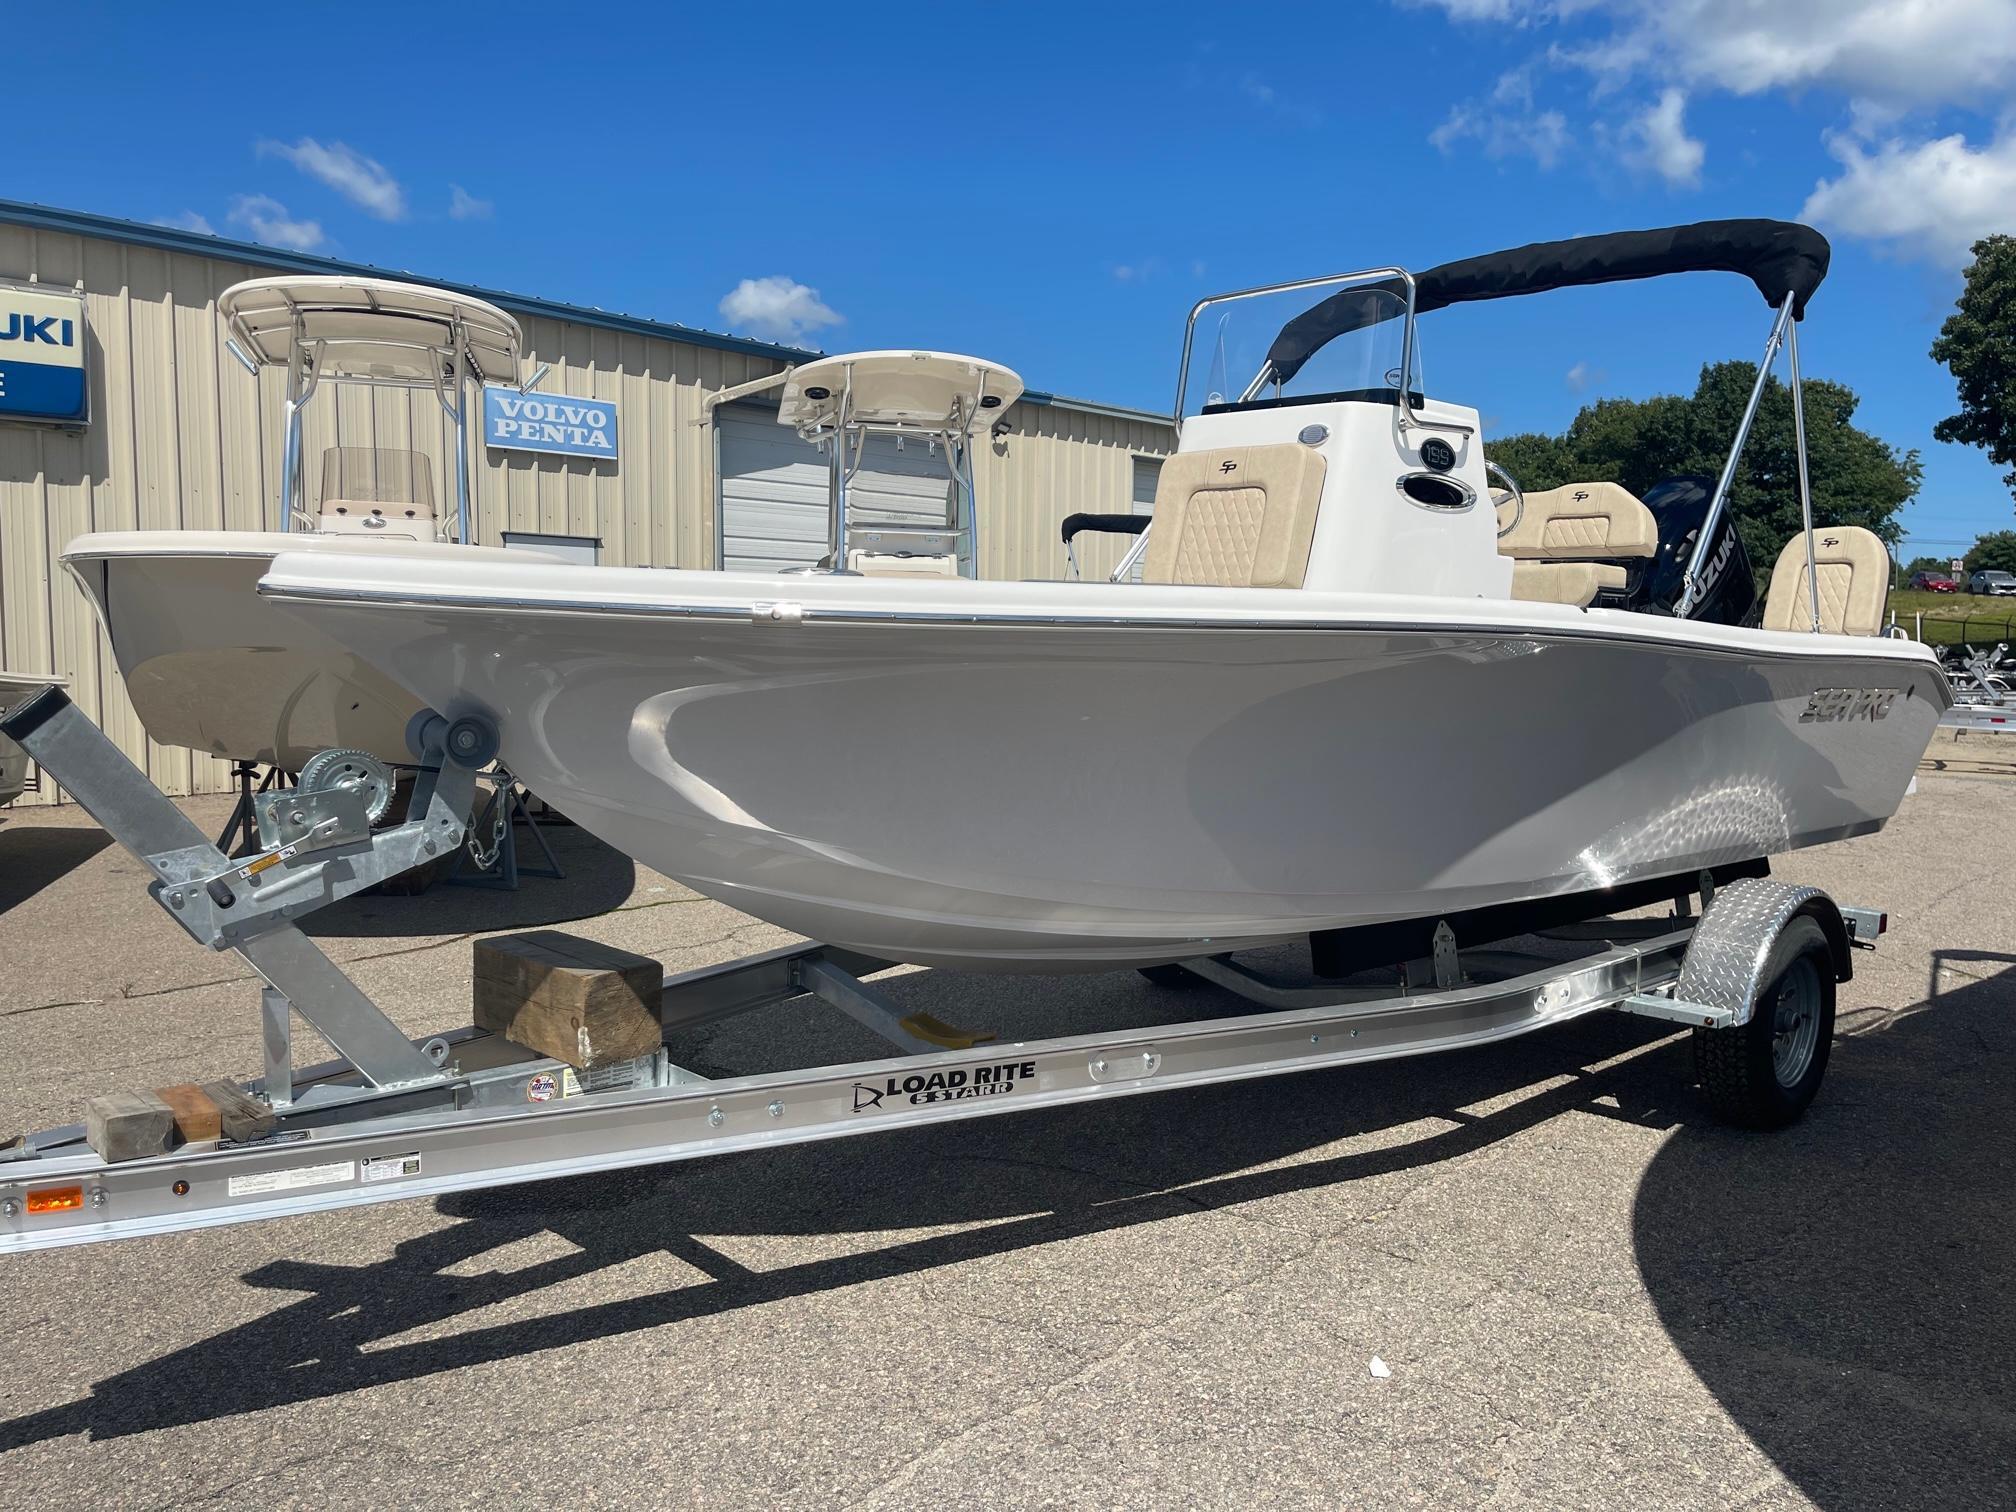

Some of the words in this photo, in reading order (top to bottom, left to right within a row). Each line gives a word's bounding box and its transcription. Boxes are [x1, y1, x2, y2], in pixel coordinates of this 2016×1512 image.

[494, 397, 607, 428] VOLVO
[494, 418, 612, 448] PENTA
[886, 1070, 968, 1097] LOAD
[974, 1061, 1036, 1085] RITE
[933, 1082, 1009, 1101] STARR
